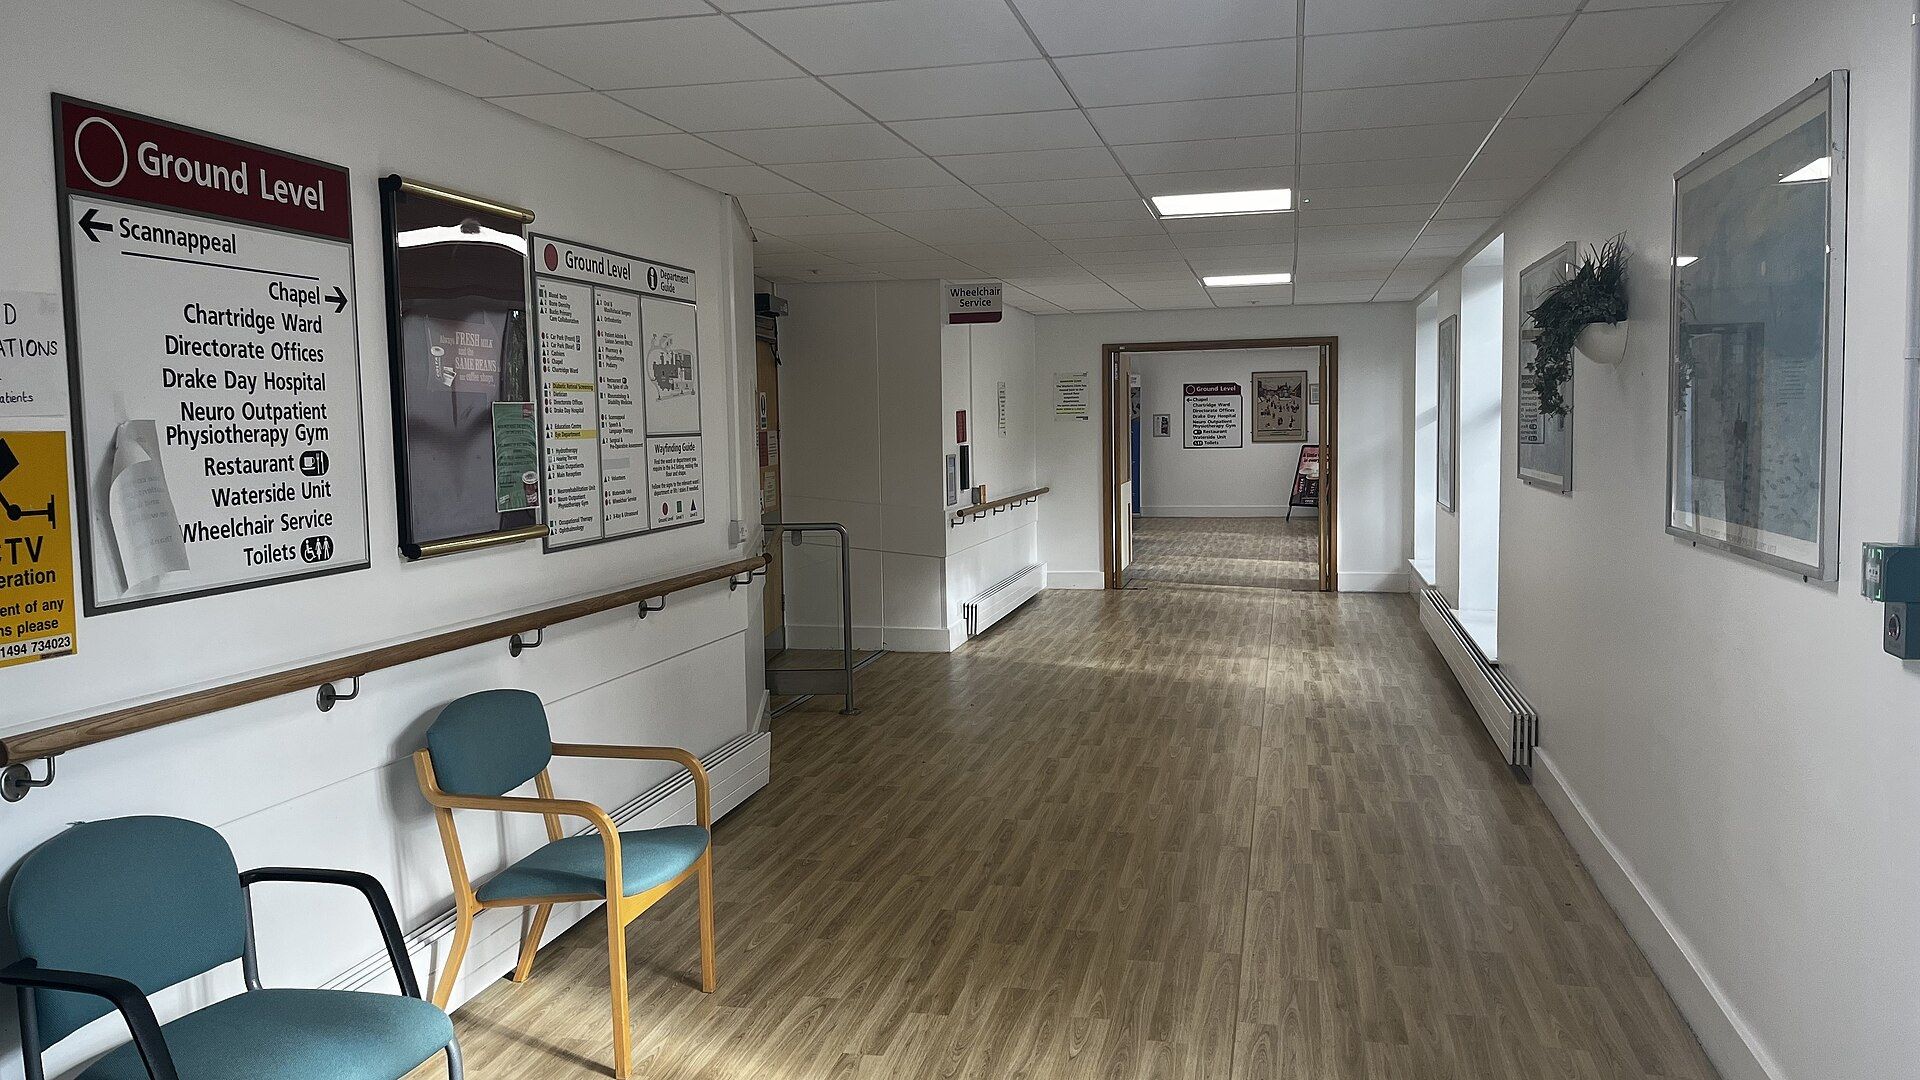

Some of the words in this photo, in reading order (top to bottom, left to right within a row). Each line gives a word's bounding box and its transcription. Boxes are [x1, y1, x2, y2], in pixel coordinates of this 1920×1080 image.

[137, 142, 249, 195] Ground
[259, 169, 325, 212] Level
[119, 217, 236, 254] Scannappeal
[565, 250, 604, 275] Ground
[607, 259, 631, 280] Level
[660, 268, 689, 284] Department
[268, 281, 320, 307] Chapel
[660, 281, 676, 294] Guide
[950, 286, 1001, 297] Wheelchair
[959, 298, 991, 307] Service
[183, 302, 275, 334] Chartridge
[281, 312, 322, 333] Ward
[165, 334, 264, 360] Directorate
[271, 341, 324, 362] Offices
[455, 331, 480, 347] FRESH
[455, 357, 475, 371] SAME
[475, 358, 497, 372] BEANS
[162, 367, 217, 388] Drake
[224, 370, 257, 394] Day
[264, 371, 326, 395] Hospital
[180, 401, 235, 421] Neuro
[241, 401, 327, 425] Outpatient
[166, 424, 288, 450] Physiotherapy
[295, 424, 328, 446] Gym
[654, 443, 681, 455] Wayfinding
[682, 442, 696, 452] Guide
[204, 454, 294, 476] Restaurant
[211, 482, 295, 507] Waterside
[301, 479, 332, 499] Unit
[180, 514, 274, 543] Wheelchair
[280, 509, 333, 532] Service
[0, 535, 44, 565] TV
[243, 543, 296, 566] Toilets
[24, 600, 38, 614] of
[42, 599, 65, 612] any
[17, 619, 59, 637] please
[31, 636, 71, 652] 734023
